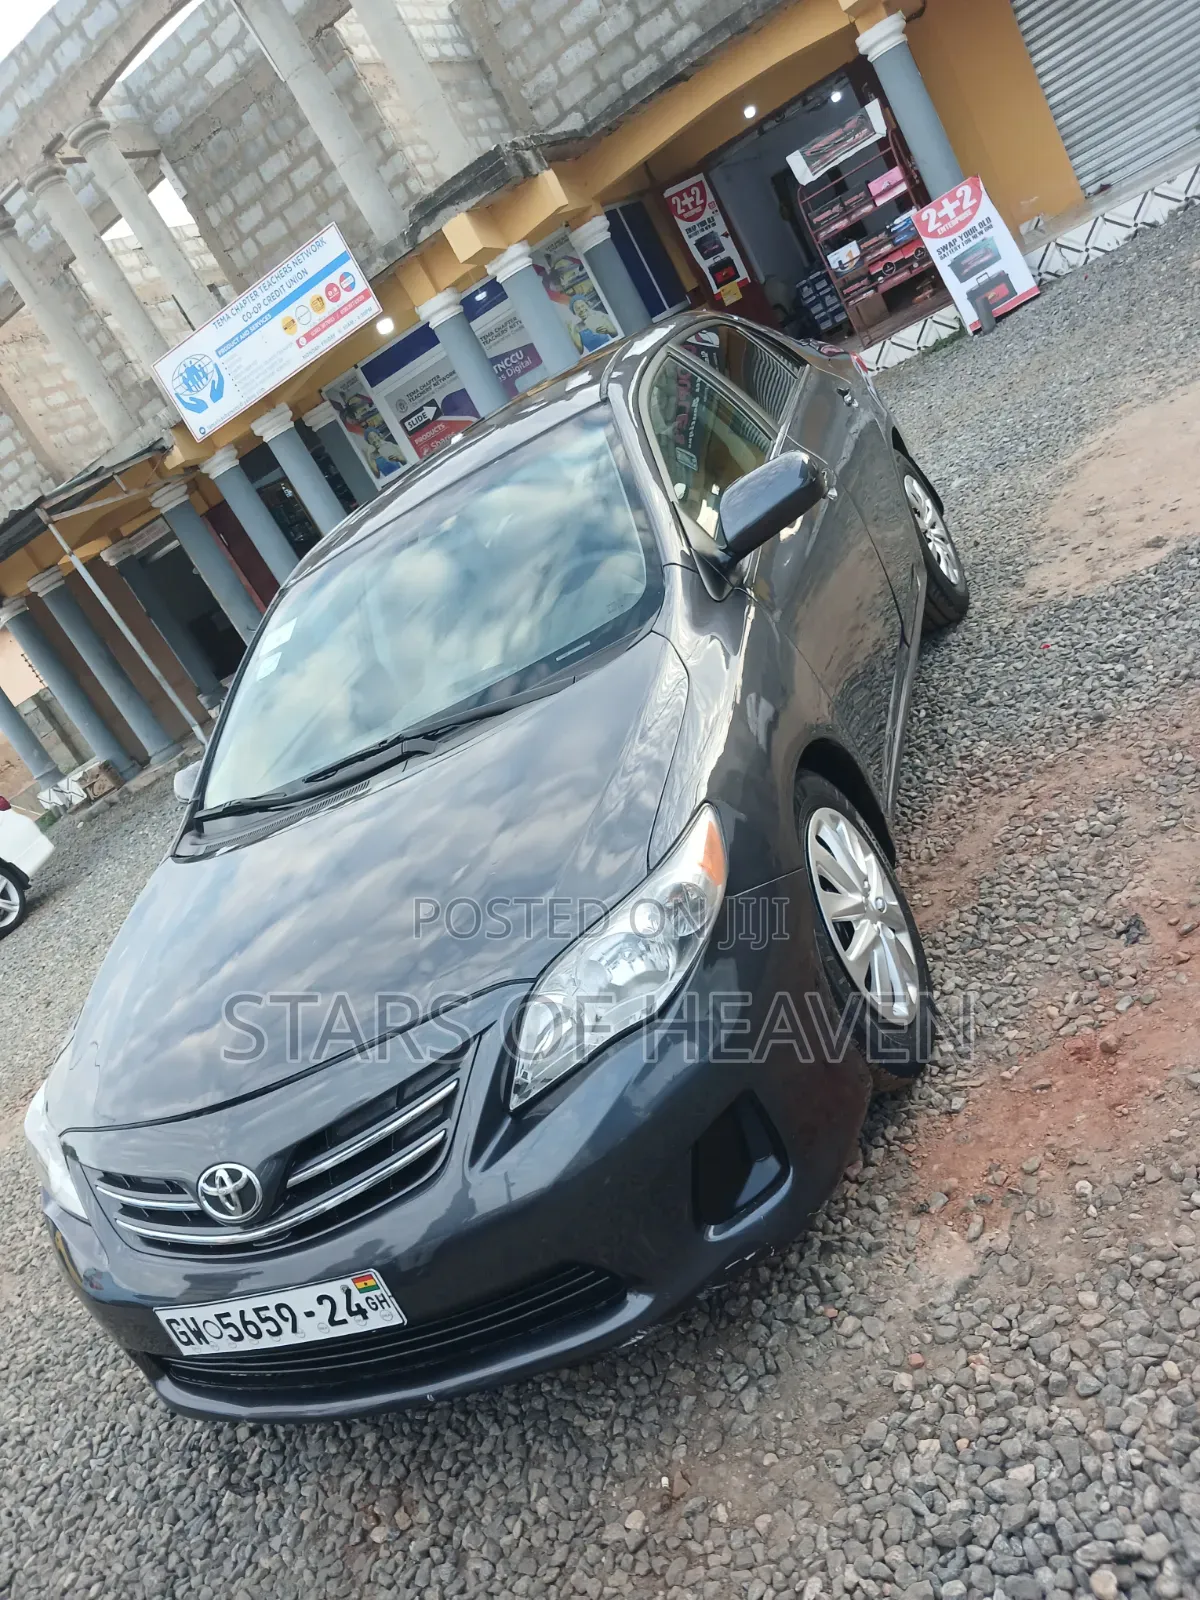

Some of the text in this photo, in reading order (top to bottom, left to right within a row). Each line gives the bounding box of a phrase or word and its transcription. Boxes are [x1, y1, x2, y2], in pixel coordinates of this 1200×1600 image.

[672, 186, 704, 215] 2+2
[921, 184, 977, 233] 2+2
[936, 239, 957, 255] SWAP
[958, 226, 977, 241] YOUR
[978, 217, 992, 229] OLD
[940, 245, 961, 260] BATTERY
[213, 237, 327, 330] TEMA CHAPTER TEACHERS NETWORK
[242, 268, 309, 323] CO-OP CREDIT UNION
[218, 314, 272, 357] PRODUCT AND SERVICES
[480, 317, 517, 341] TEMA CHAPTER
[506, 356, 532, 377] Digital
[406, 375, 440, 399] TEMA CHAPTER
[408, 412, 427, 428] SLIDE
[414, 422, 446, 444] PRODUCTS
[430, 432, 456, 448] Shares
[165, 1288, 391, 1348] GW 5659-24 GH
